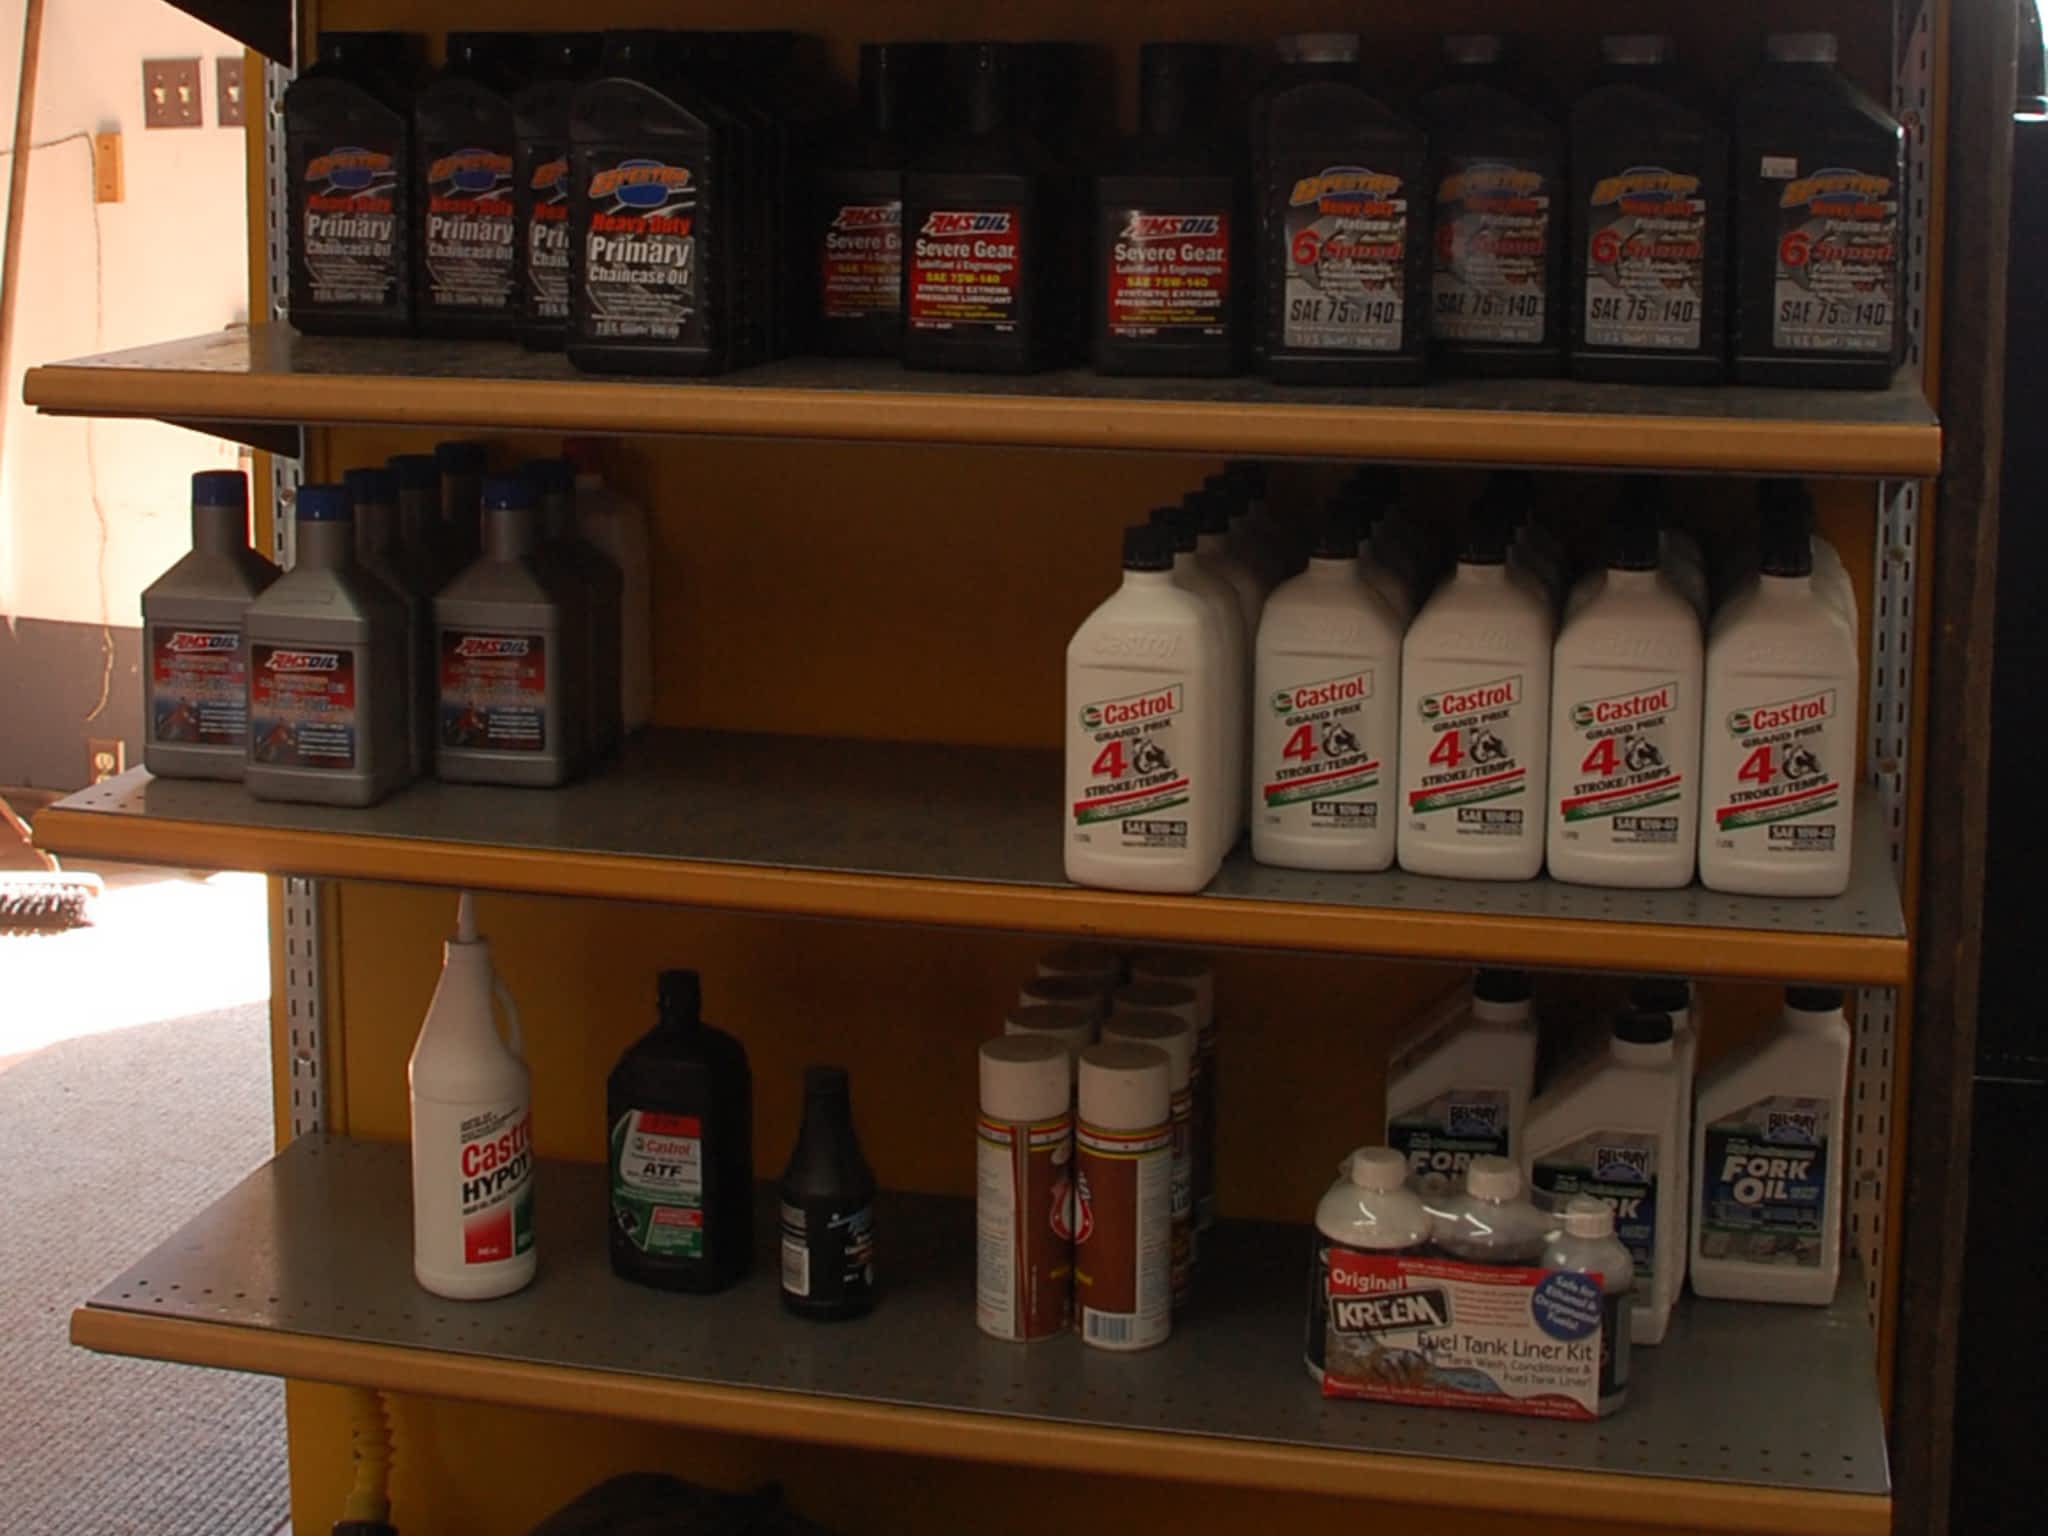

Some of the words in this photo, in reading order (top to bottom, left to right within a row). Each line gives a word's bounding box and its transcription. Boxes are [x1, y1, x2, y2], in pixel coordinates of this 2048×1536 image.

[308, 215, 392, 241] Primary
[429, 217, 514, 244] Primary
[921, 212, 1010, 236] AMSOIL
[591, 236, 688, 267] Primary
[826, 233, 881, 249] Severe
[916, 239, 970, 257] Severe
[973, 240, 1015, 258] Gear
[1115, 243, 1177, 261] Severe
[1181, 243, 1224, 261] Gear
[1292, 229, 1321, 265] 6
[1592, 229, 1621, 264] 6
[1780, 230, 1809, 266] 6
[589, 265, 665, 284] Chaincase
[667, 269, 688, 285] Oil
[1291, 299, 1322, 321] SAE
[1592, 298, 1623, 320] SAE
[1781, 300, 1810, 323] SAE
[167, 632, 239, 651] AMSOIL
[455, 637, 528, 656] AMSOIL
[265, 650, 339, 671] AMSOIL
[1295, 676, 1364, 708] Castrol
[1442, 682, 1513, 715] Castrol
[1104, 691, 1174, 725] Castrol
[1285, 710, 1330, 726] GRAND
[1333, 702, 1361, 717] PRIX
[1596, 689, 1668, 723] Castrol
[1753, 696, 1826, 730] Castrol
[1094, 726, 1140, 742] GRAND
[1143, 718, 1171, 733] PRIX
[1432, 717, 1478, 733] GRAND
[1481, 709, 1510, 724] PRIX
[1585, 724, 1633, 740] GRAND
[1635, 716, 1665, 731] PRIX
[1282, 723, 1318, 761] 4
[1429, 730, 1465, 768] 4
[1741, 731, 1791, 748] GRAND
[1793, 723, 1823, 738] PRIX
[1091, 740, 1127, 778] 4
[1276, 752, 1369, 780] STROKE/TEMPS
[1582, 737, 1620, 777] 4
[1738, 745, 1777, 784] 4
[1084, 769, 1179, 797] STROKE/TEMPS
[1421, 759, 1515, 787] STROKE/TEMPS
[1574, 766, 1671, 796] STROKE/TEMPS
[1729, 774, 1829, 804] STROKE/TEMPS
[462, 1120, 531, 1178] Castr
[647, 1140, 691, 1157] Castrol
[1409, 1151, 1472, 1172] FOR
[643, 1162, 682, 1178] ATF
[1721, 1155, 1811, 1182] FORK
[1733, 1177, 1788, 1205] OIL
[1332, 1268, 1405, 1292] Original
[1337, 1295, 1444, 1328] KREEM
[1417, 1330, 1458, 1351] Fuel
[1463, 1336, 1507, 1356] Tank
[1513, 1341, 1561, 1360] Liner
[1566, 1343, 1592, 1361] Kit
